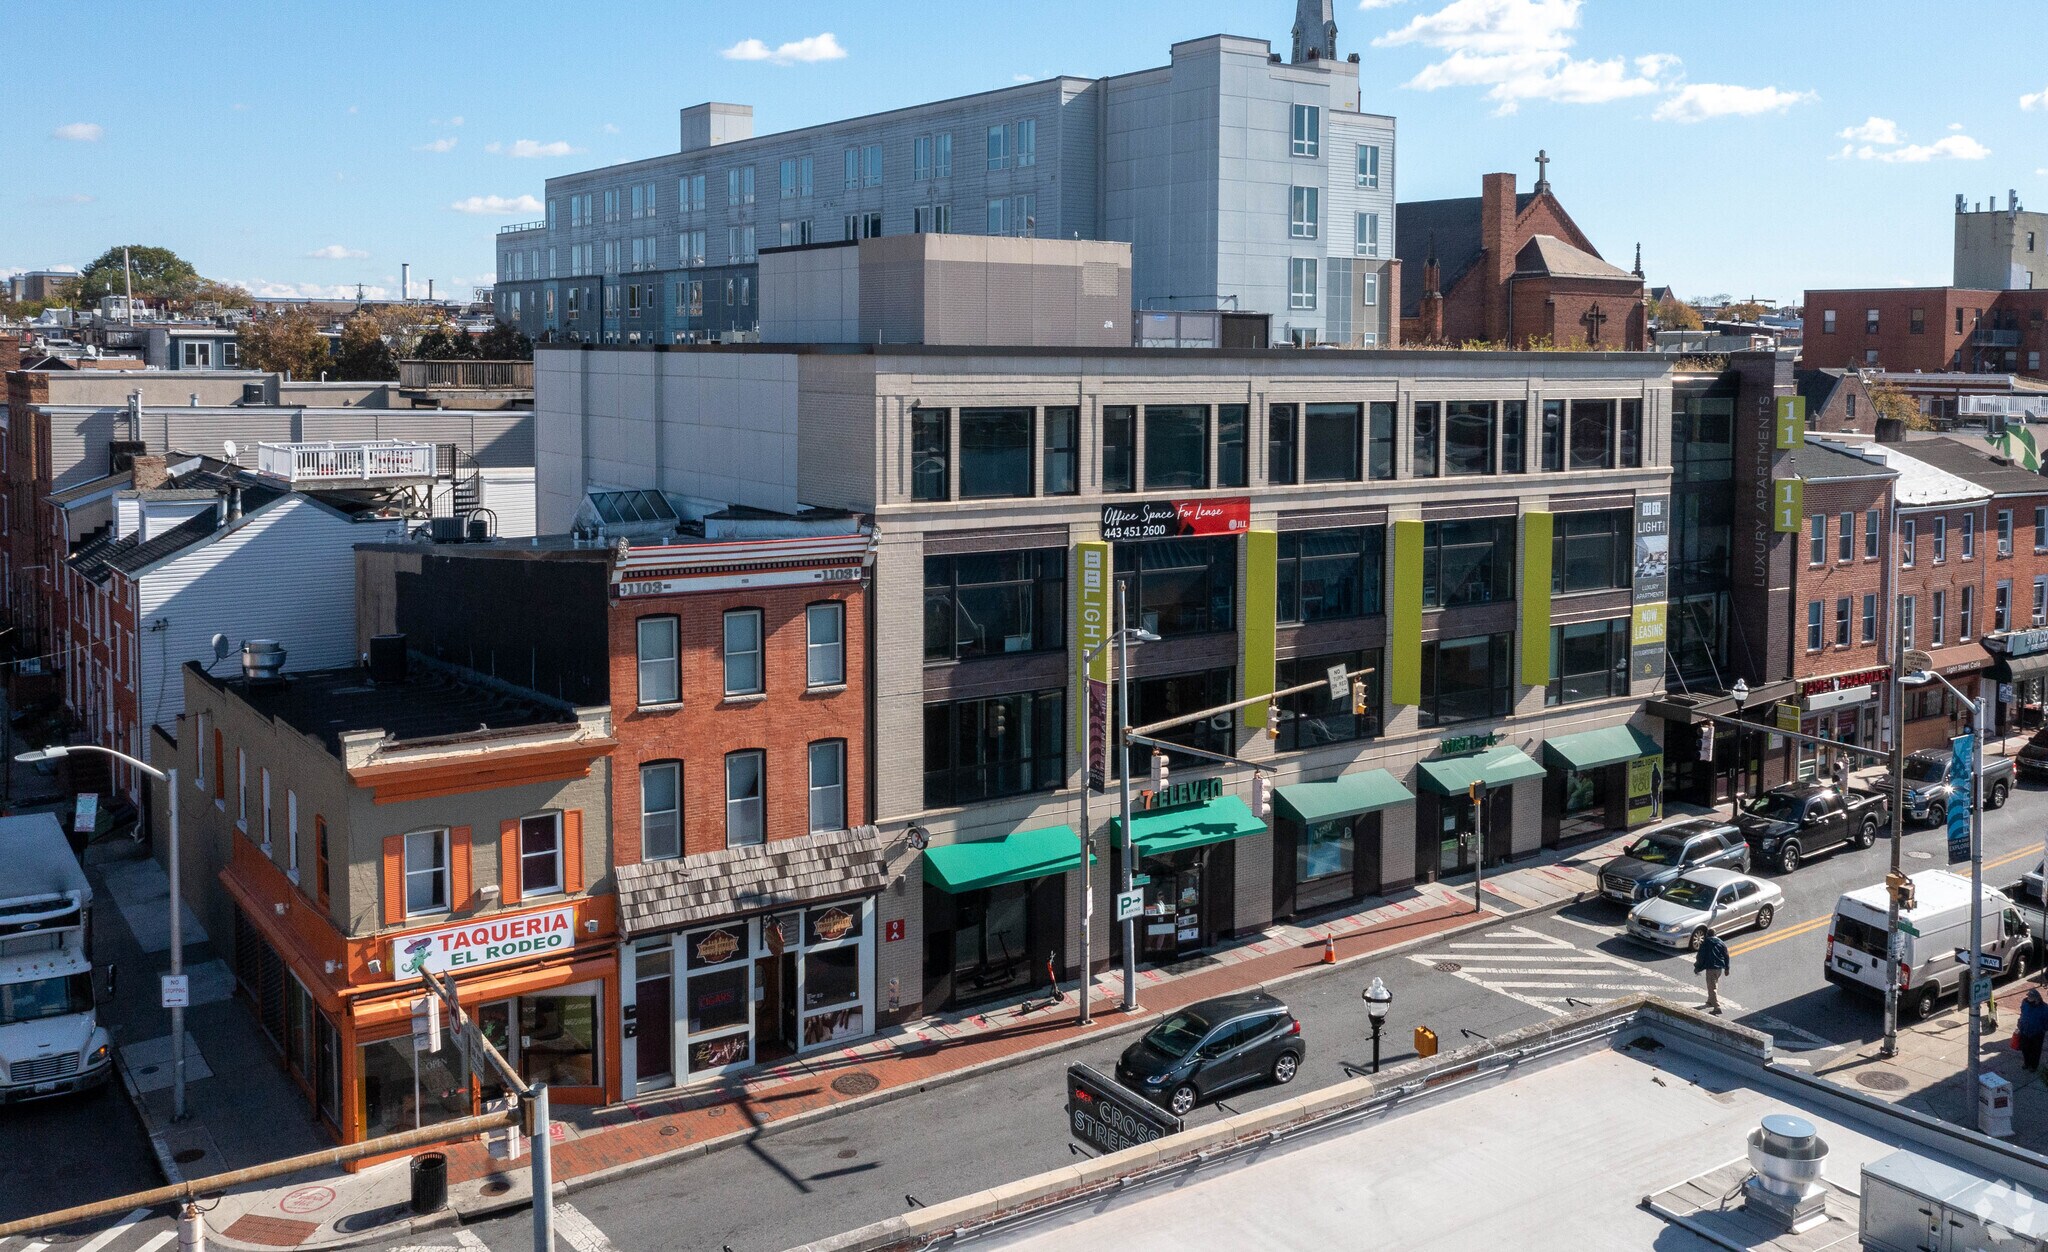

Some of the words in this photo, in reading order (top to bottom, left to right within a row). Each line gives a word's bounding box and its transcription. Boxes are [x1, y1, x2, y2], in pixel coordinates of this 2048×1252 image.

[1757, 396, 1770, 512] APARTMENTS
[1104, 507, 1139, 526] Office
[1140, 504, 1175, 523] Space
[1176, 503, 1193, 519] For
[1194, 503, 1223, 520] Lease
[1104, 527, 1122, 539] 443
[1123, 526, 1141, 537] 451
[1143, 524, 1166, 536] 2600
[1637, 521, 1662, 533] LIGHT
[1754, 519, 1767, 587] LUXURY
[821, 568, 854, 582] 1103
[627, 581, 663, 595] 1103
[1635, 590, 1665, 599] APARTMENTS
[1641, 583, 1659, 591] LUXURY
[1641, 608, 1658, 623] NOW
[1635, 623, 1664, 640] LEASING
[437, 913, 569, 952] TAQUERIA
[451, 951, 478, 966] EL
[486, 934, 562, 959] RODEO
[1074, 1110, 1136, 1152] STREE
